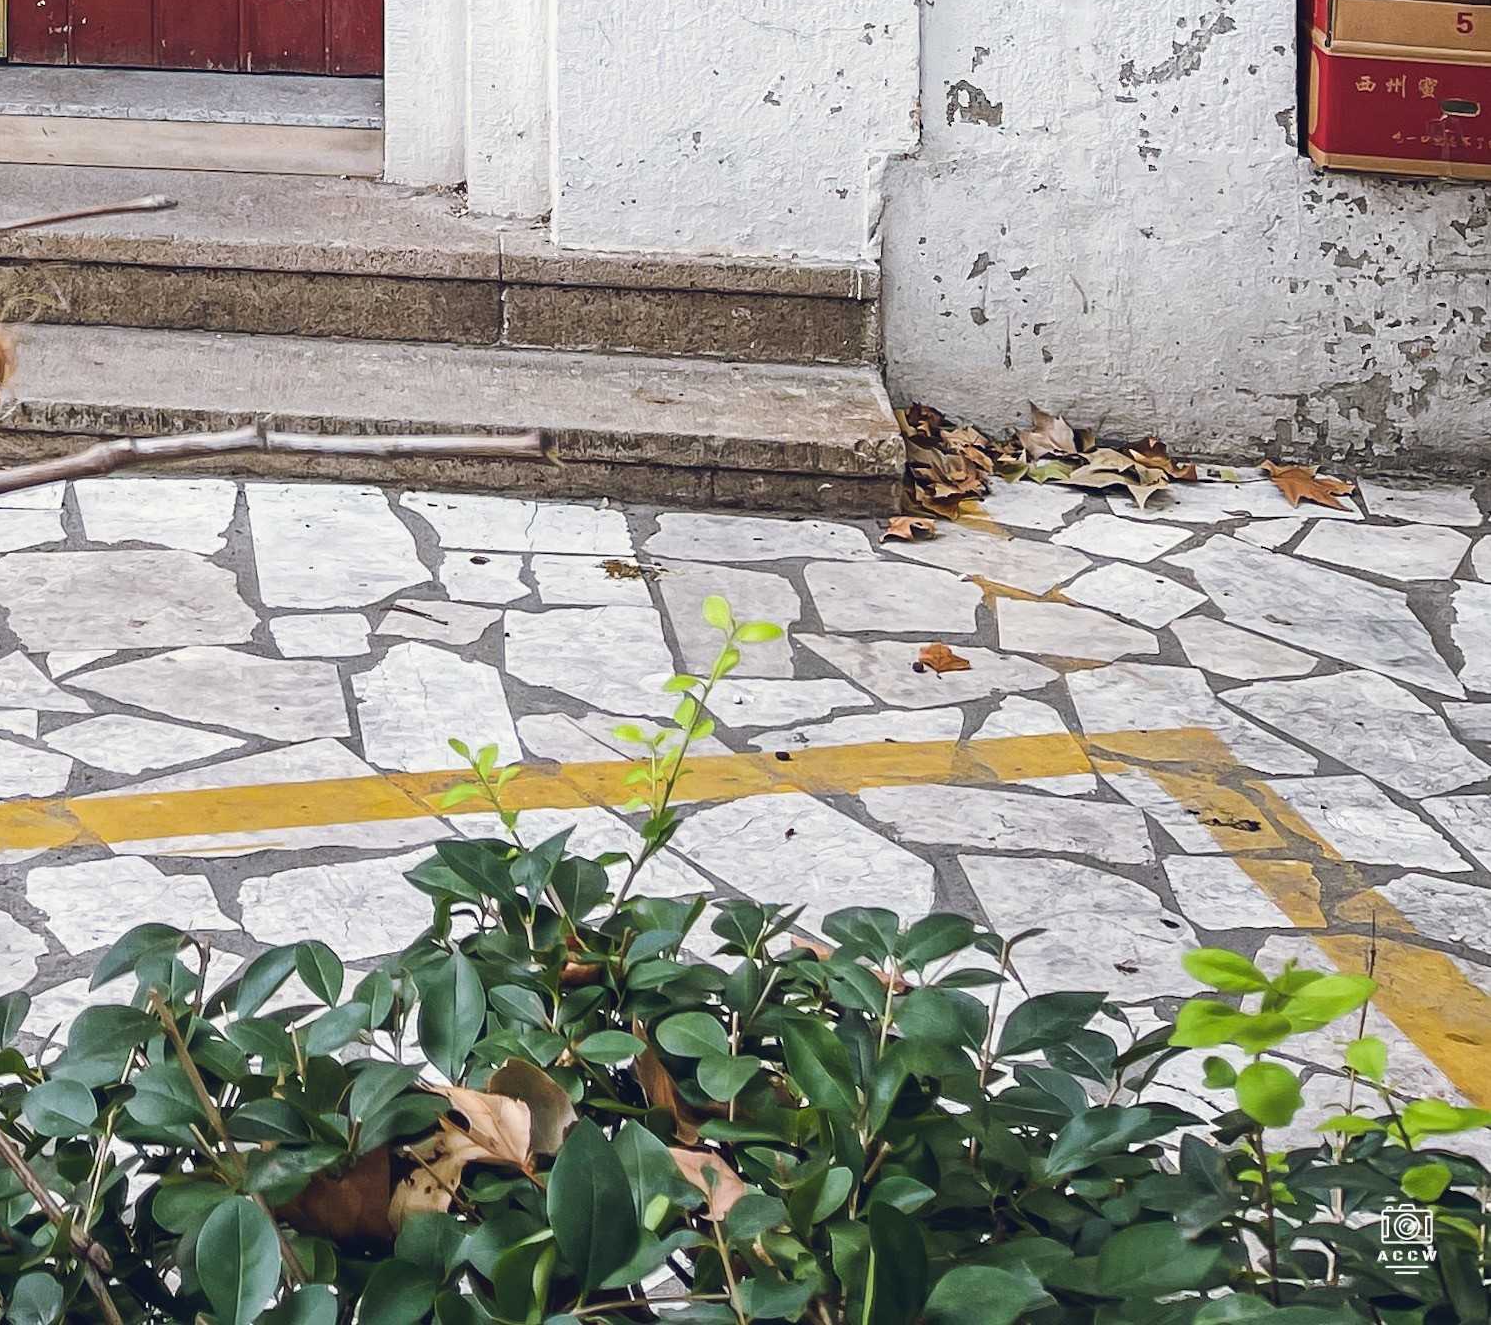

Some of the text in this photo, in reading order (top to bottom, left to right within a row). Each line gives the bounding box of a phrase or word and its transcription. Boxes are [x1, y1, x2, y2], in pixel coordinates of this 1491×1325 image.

[1456, 12, 1474, 34] 5
[1355, 74, 1438, 99] 西州蜜
